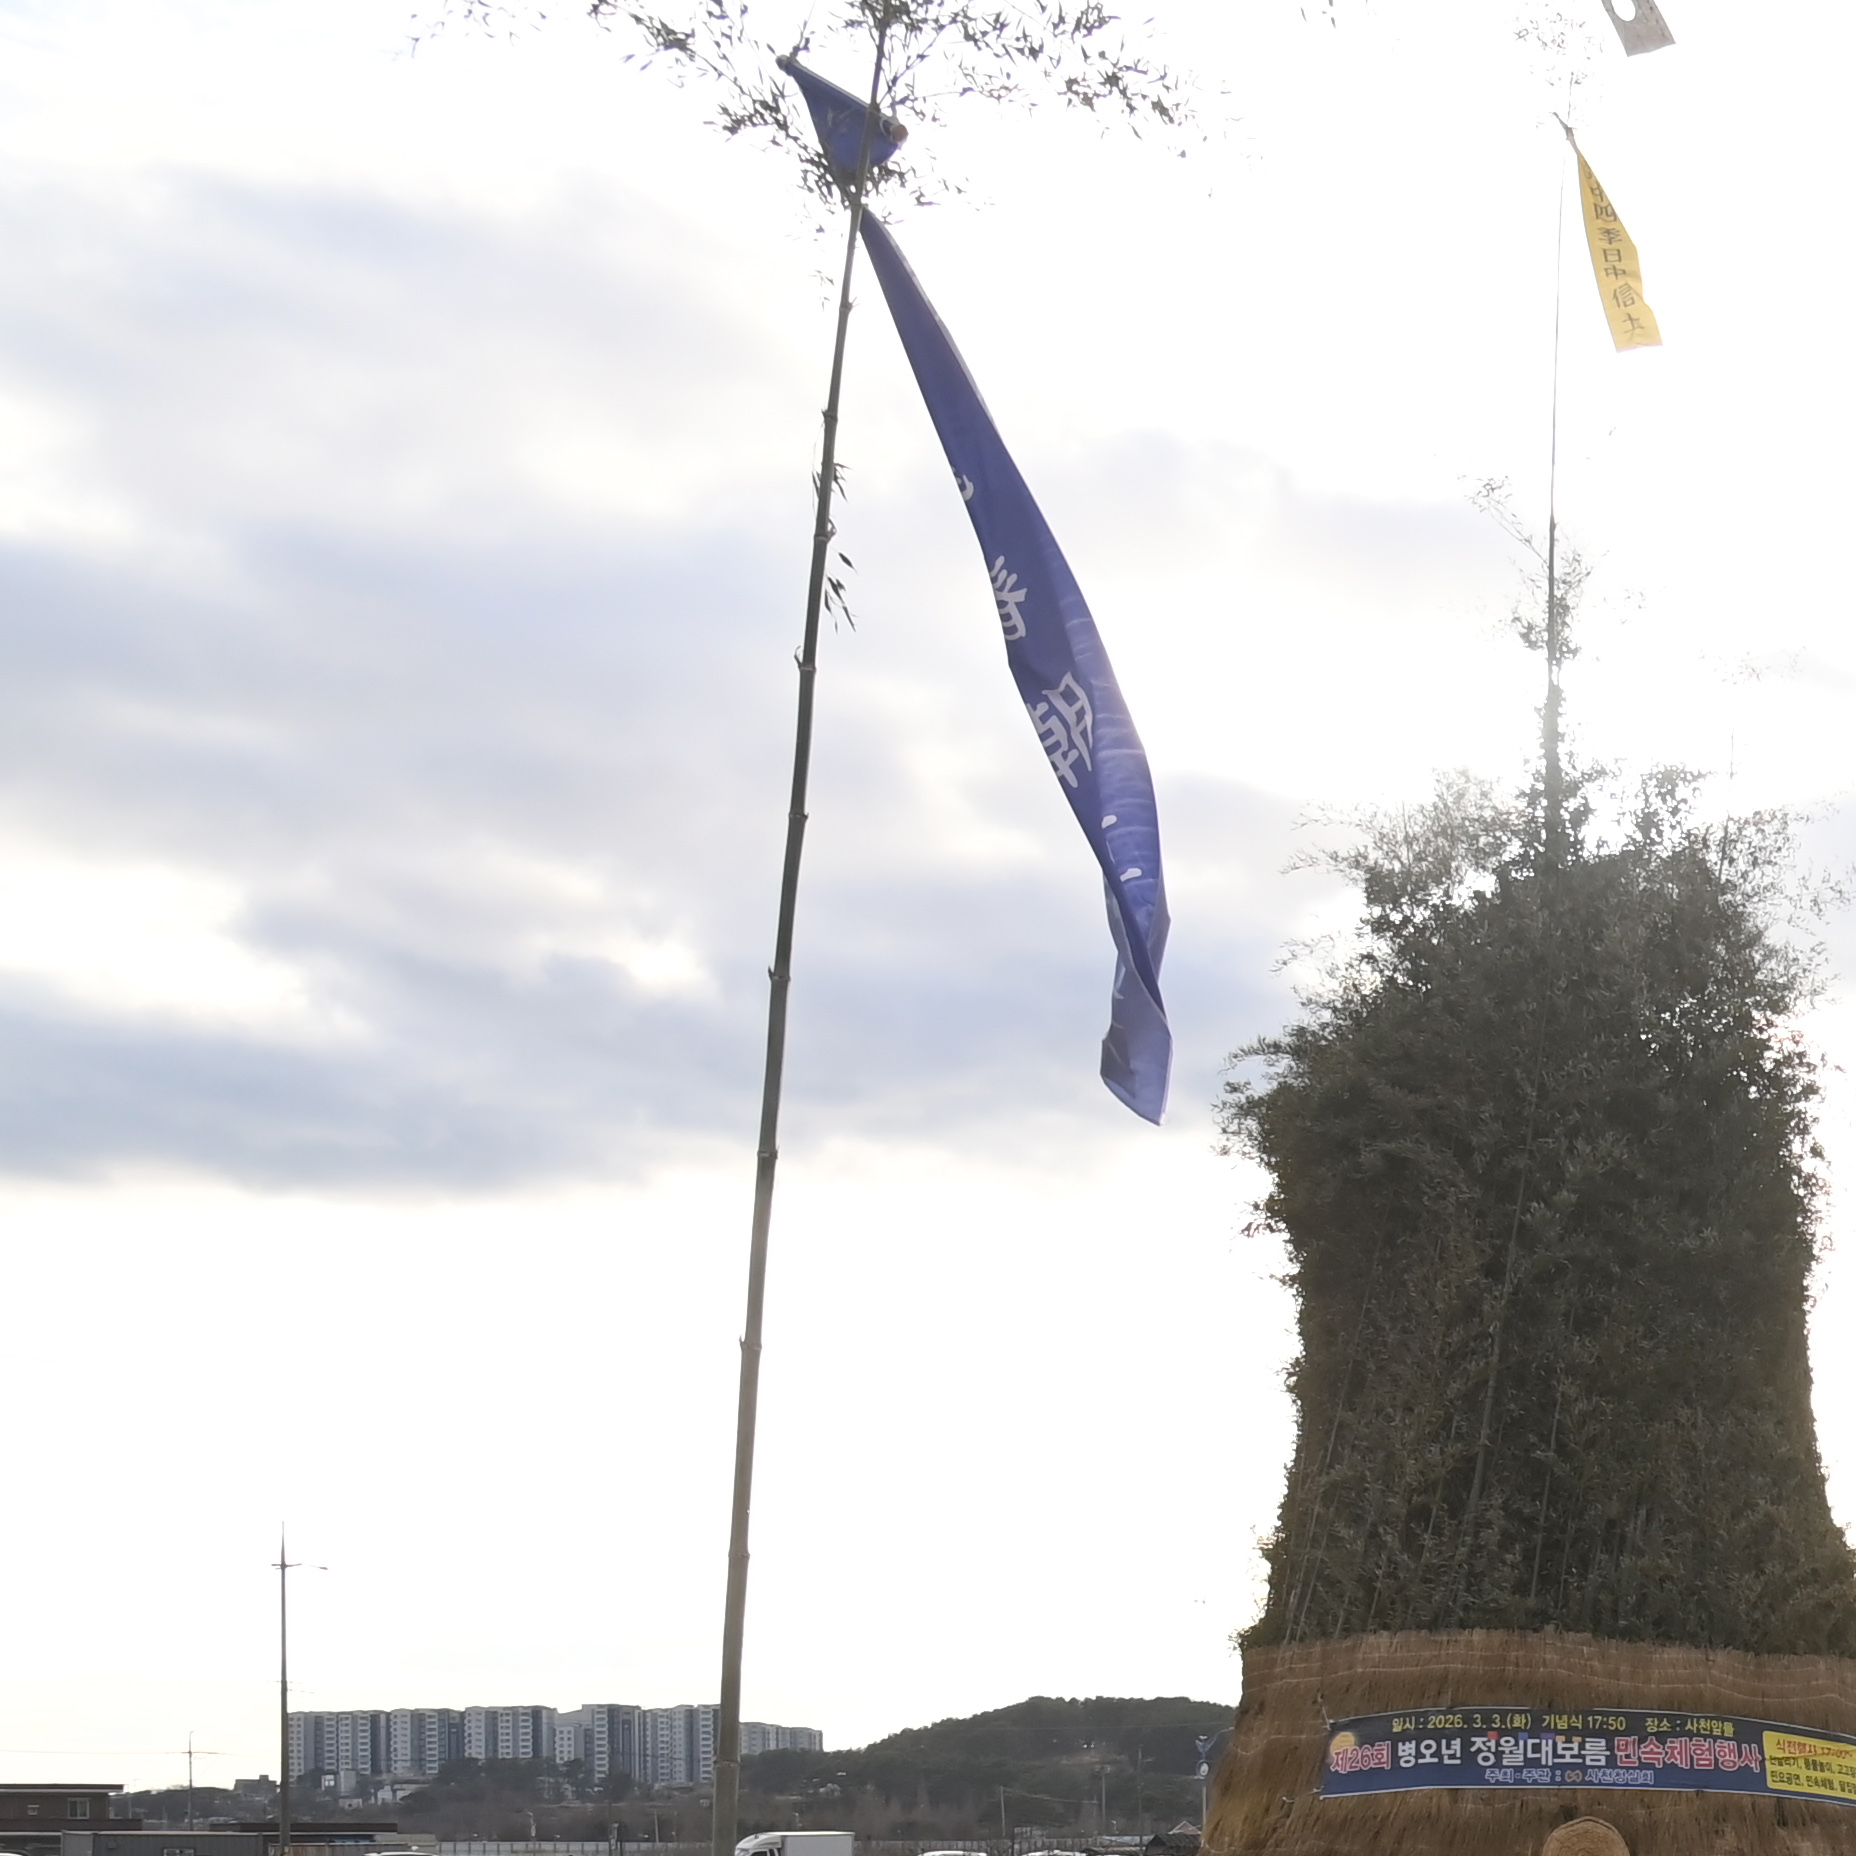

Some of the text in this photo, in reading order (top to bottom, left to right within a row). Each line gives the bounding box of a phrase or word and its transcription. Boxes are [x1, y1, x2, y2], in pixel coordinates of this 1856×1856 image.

[1392, 1715, 1416, 1732] 일시
[1427, 1714, 1468, 1729] 2026.
[1473, 1713, 1487, 1728] 3.
[1542, 1713, 1583, 1730] 기념식
[1587, 1714, 1627, 1731] 17:50
[1645, 1717, 1672, 1733] 장소
[1330, 1735, 1762, 1774] 제26회 병오년 정월대보름 민속체험행사
